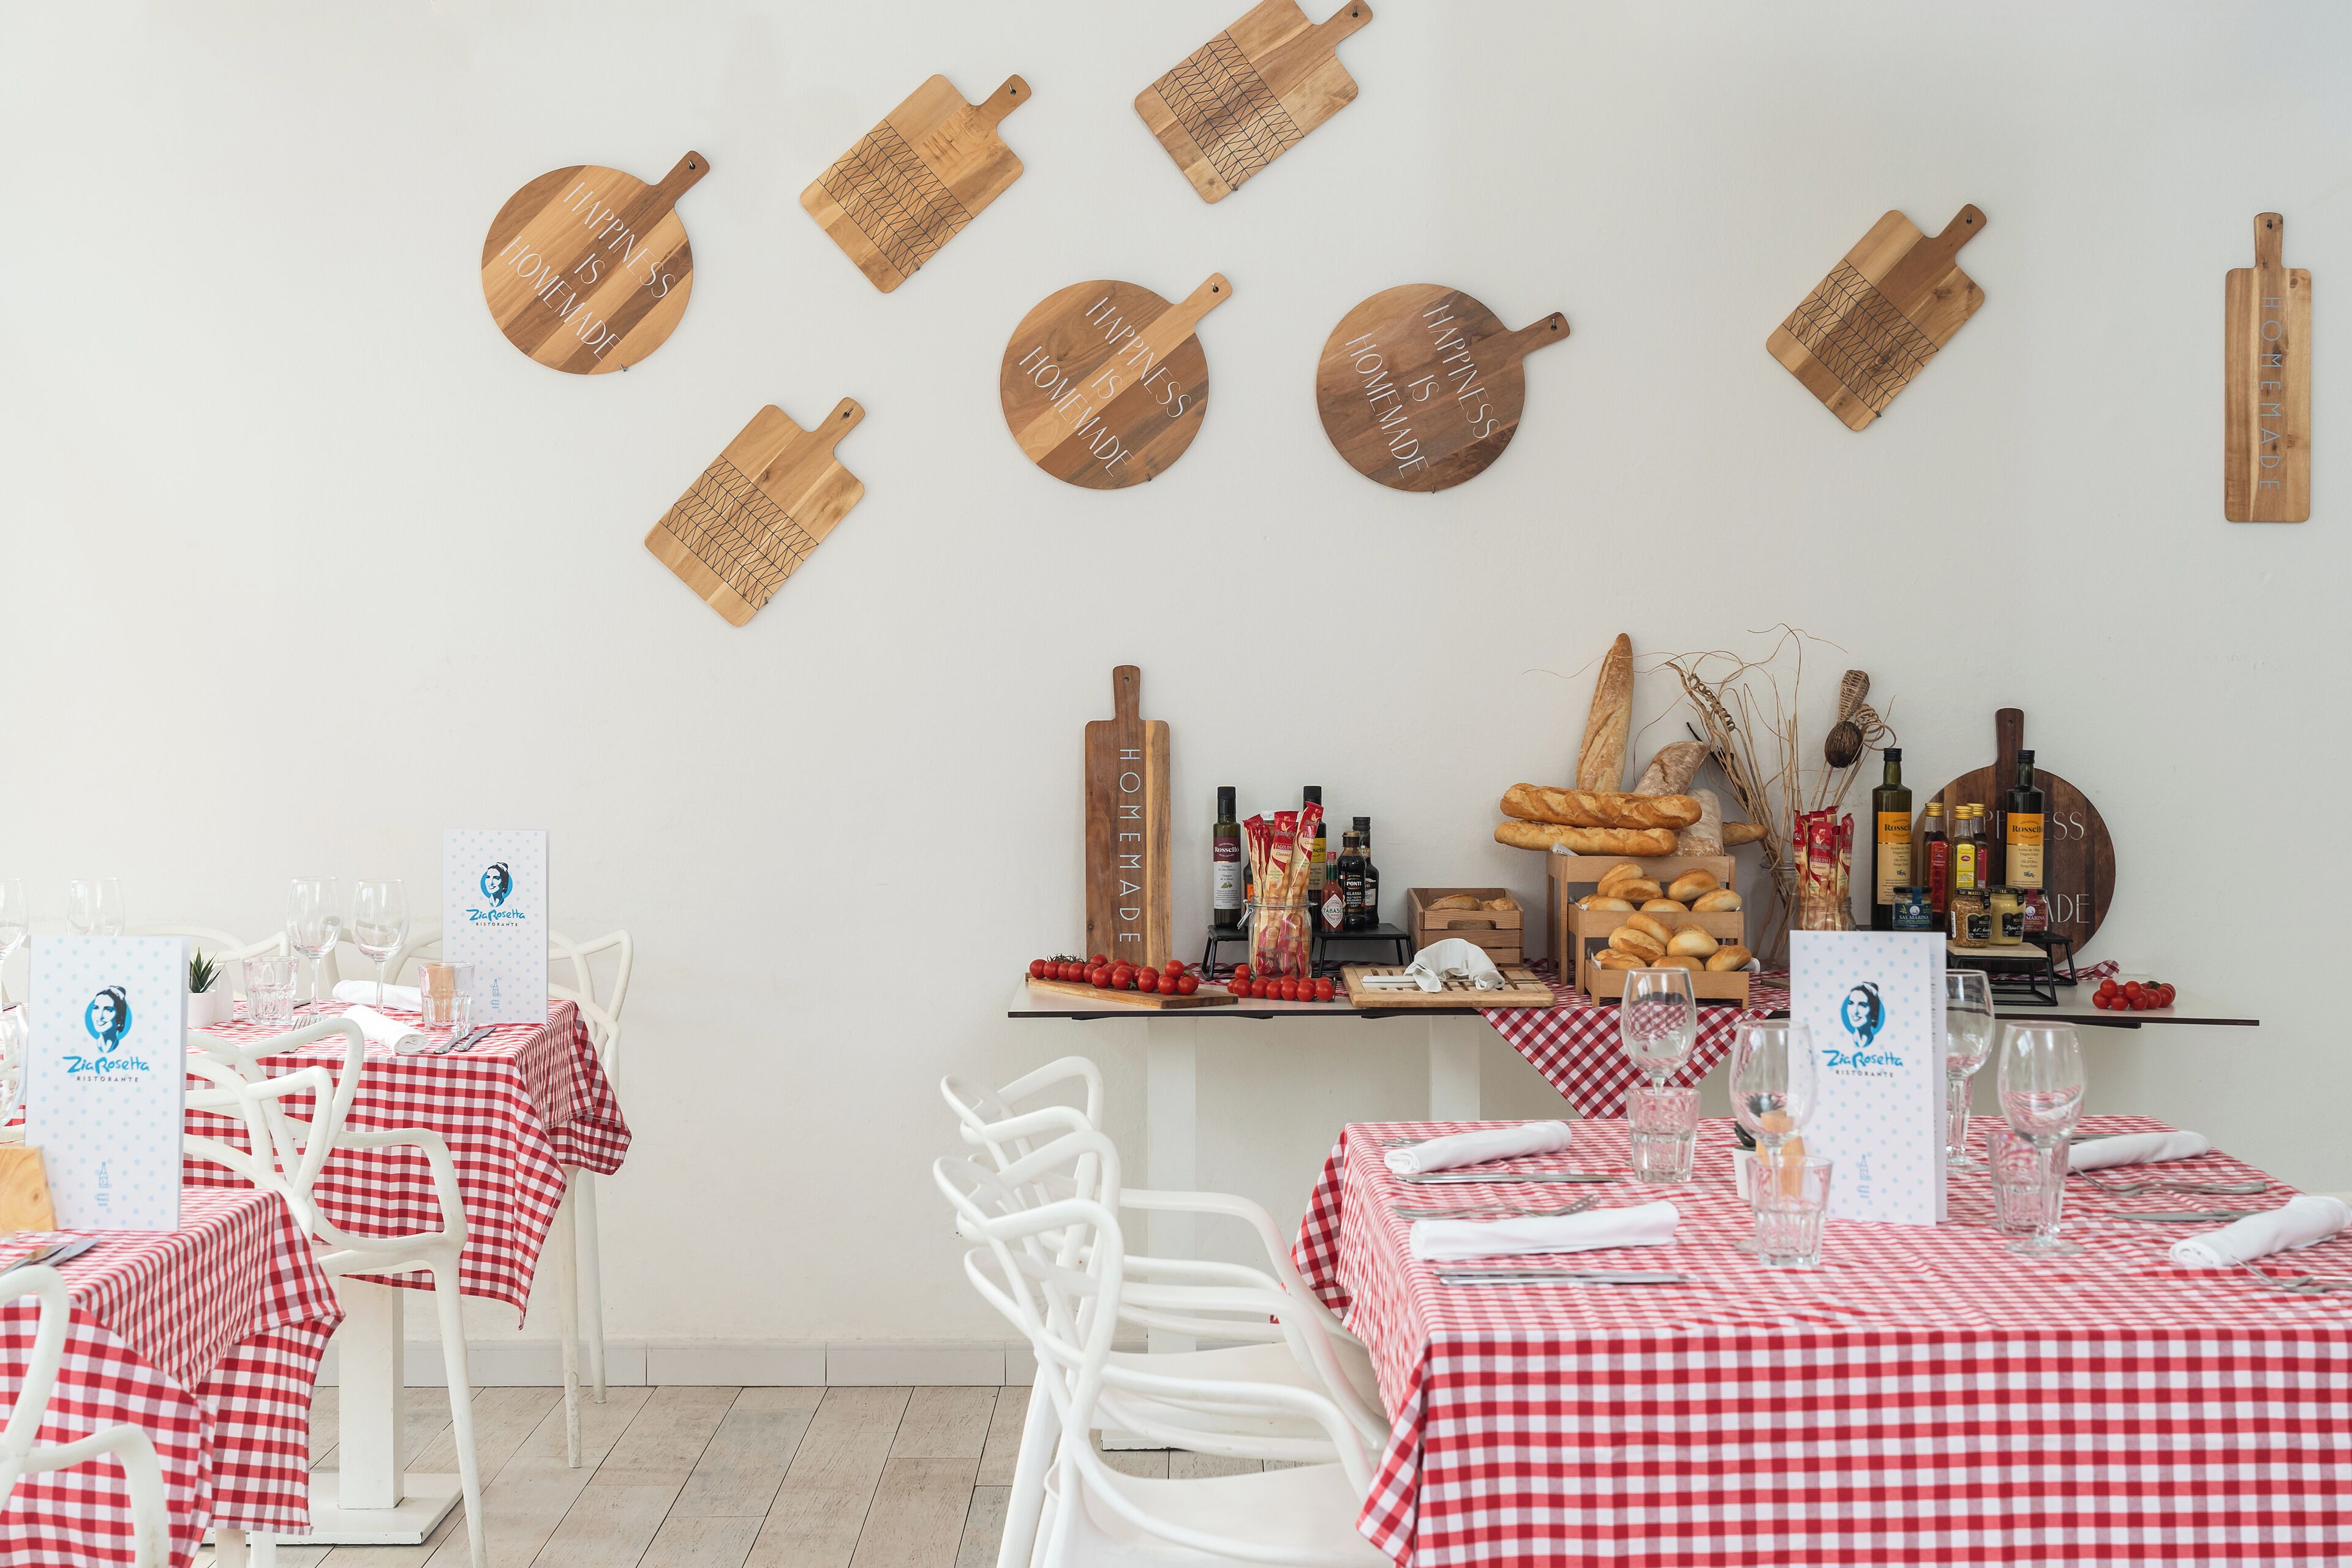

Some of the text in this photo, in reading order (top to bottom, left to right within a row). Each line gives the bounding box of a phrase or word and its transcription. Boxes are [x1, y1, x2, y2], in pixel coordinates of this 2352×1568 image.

[499, 235, 623, 362] HOMEMADE
[563, 181, 676, 298] HAPPINESS
[573, 252, 606, 284] IS
[1019, 345, 1135, 478] HOMEMADE
[1085, 296, 1191, 418] HAPPINESS
[1091, 368, 1123, 399] IS
[1344, 333, 1429, 479] HOMEMADE
[1408, 374, 1439, 402] IS
[1422, 304, 1500, 439] HAPPINESS
[2258, 296, 2283, 490] HOMEMADE
[1119, 748, 1142, 942] HOMEMADE
[1835, 1069, 1893, 1078] RISTORANTE
